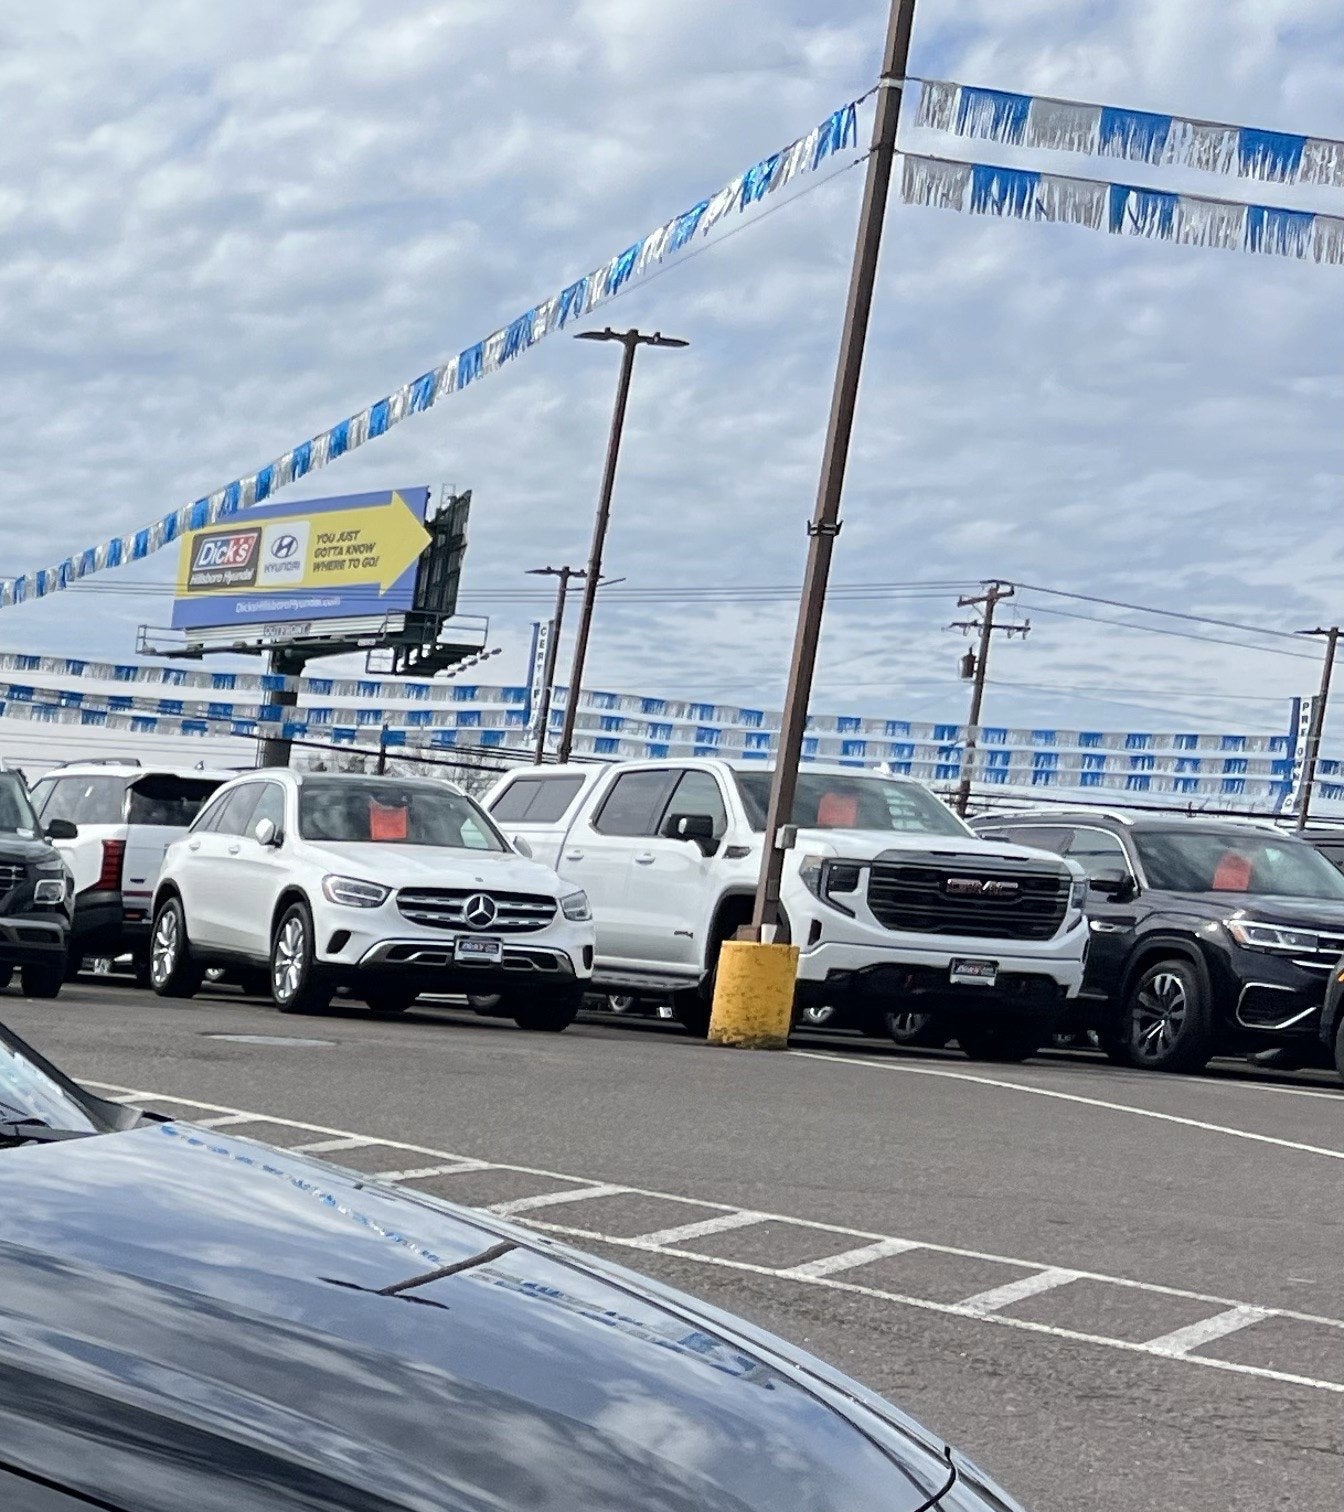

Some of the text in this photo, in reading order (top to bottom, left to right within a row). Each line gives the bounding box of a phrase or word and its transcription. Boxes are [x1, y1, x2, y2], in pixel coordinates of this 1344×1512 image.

[317, 529, 361, 545] YOU JUST
[199, 538, 249, 566] Dick's
[314, 542, 376, 558] GOTTA KNOW
[313, 556, 380, 573] WHERE TO GO!
